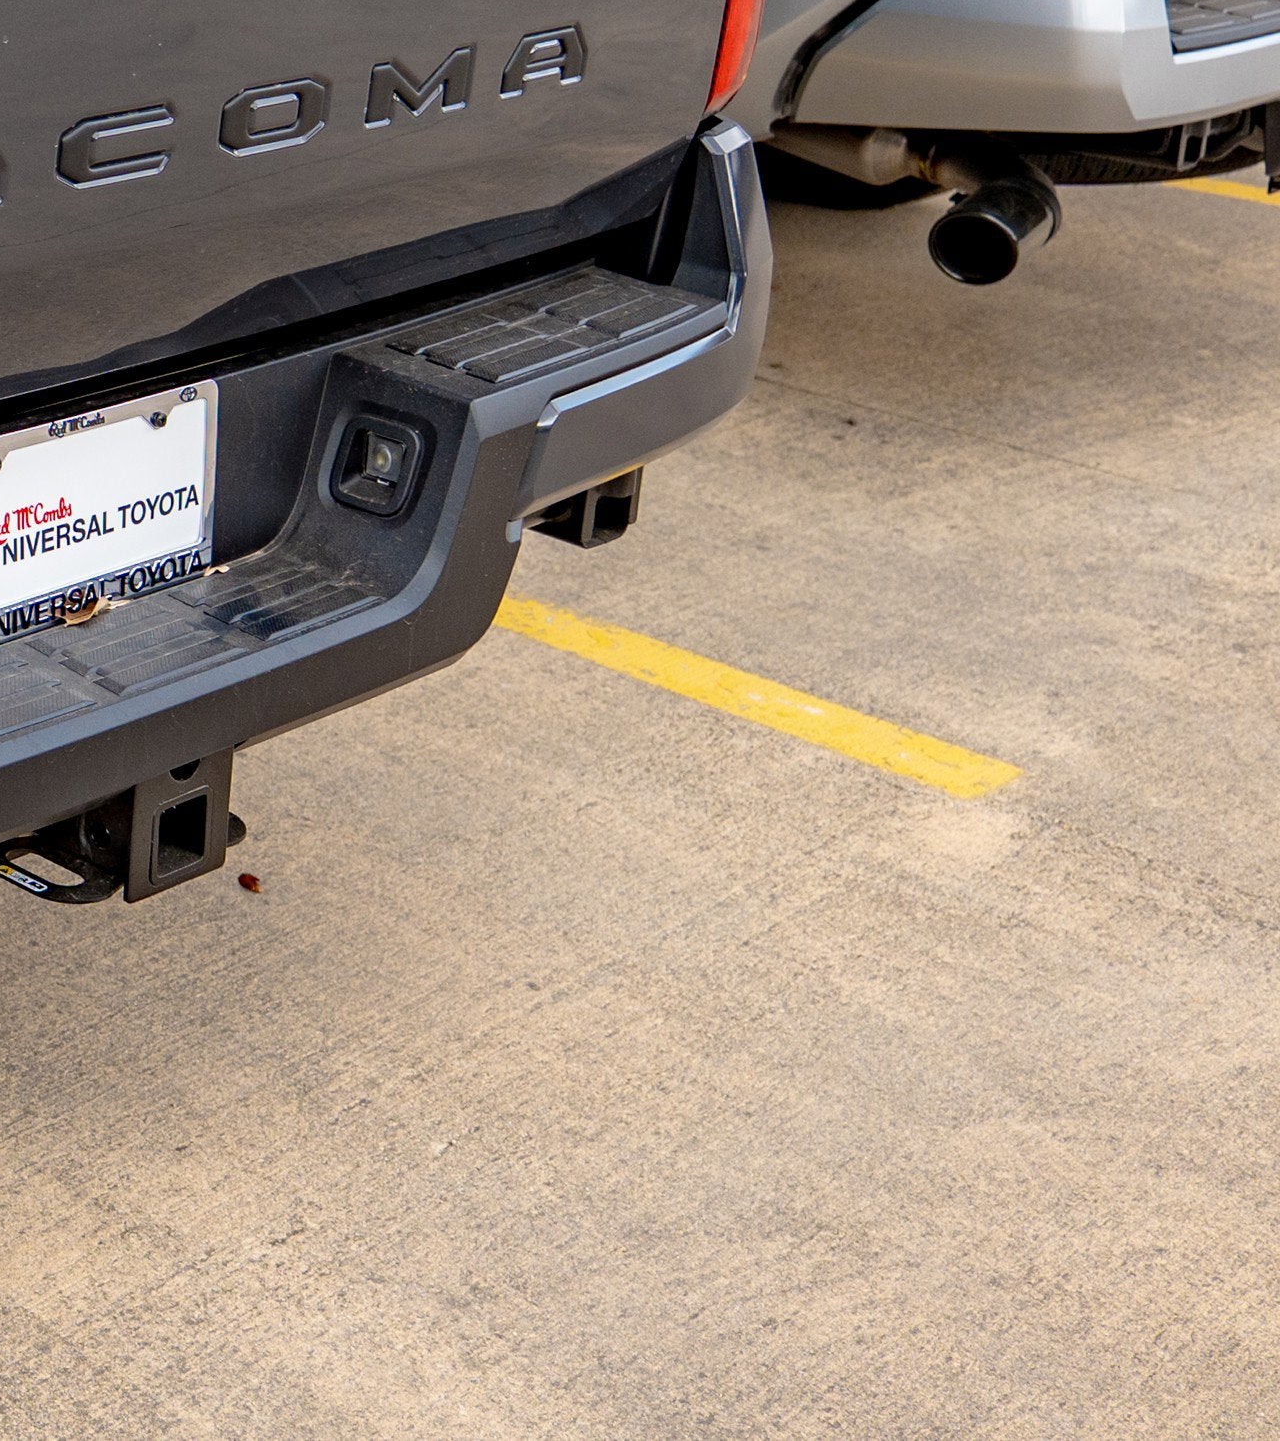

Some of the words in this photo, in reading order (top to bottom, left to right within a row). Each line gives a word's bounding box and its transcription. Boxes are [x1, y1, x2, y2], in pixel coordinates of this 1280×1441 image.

[13, 497, 72, 530] McCombs
[117, 484, 199, 529] TOYOTA
[114, 549, 204, 597] TOYOTA
